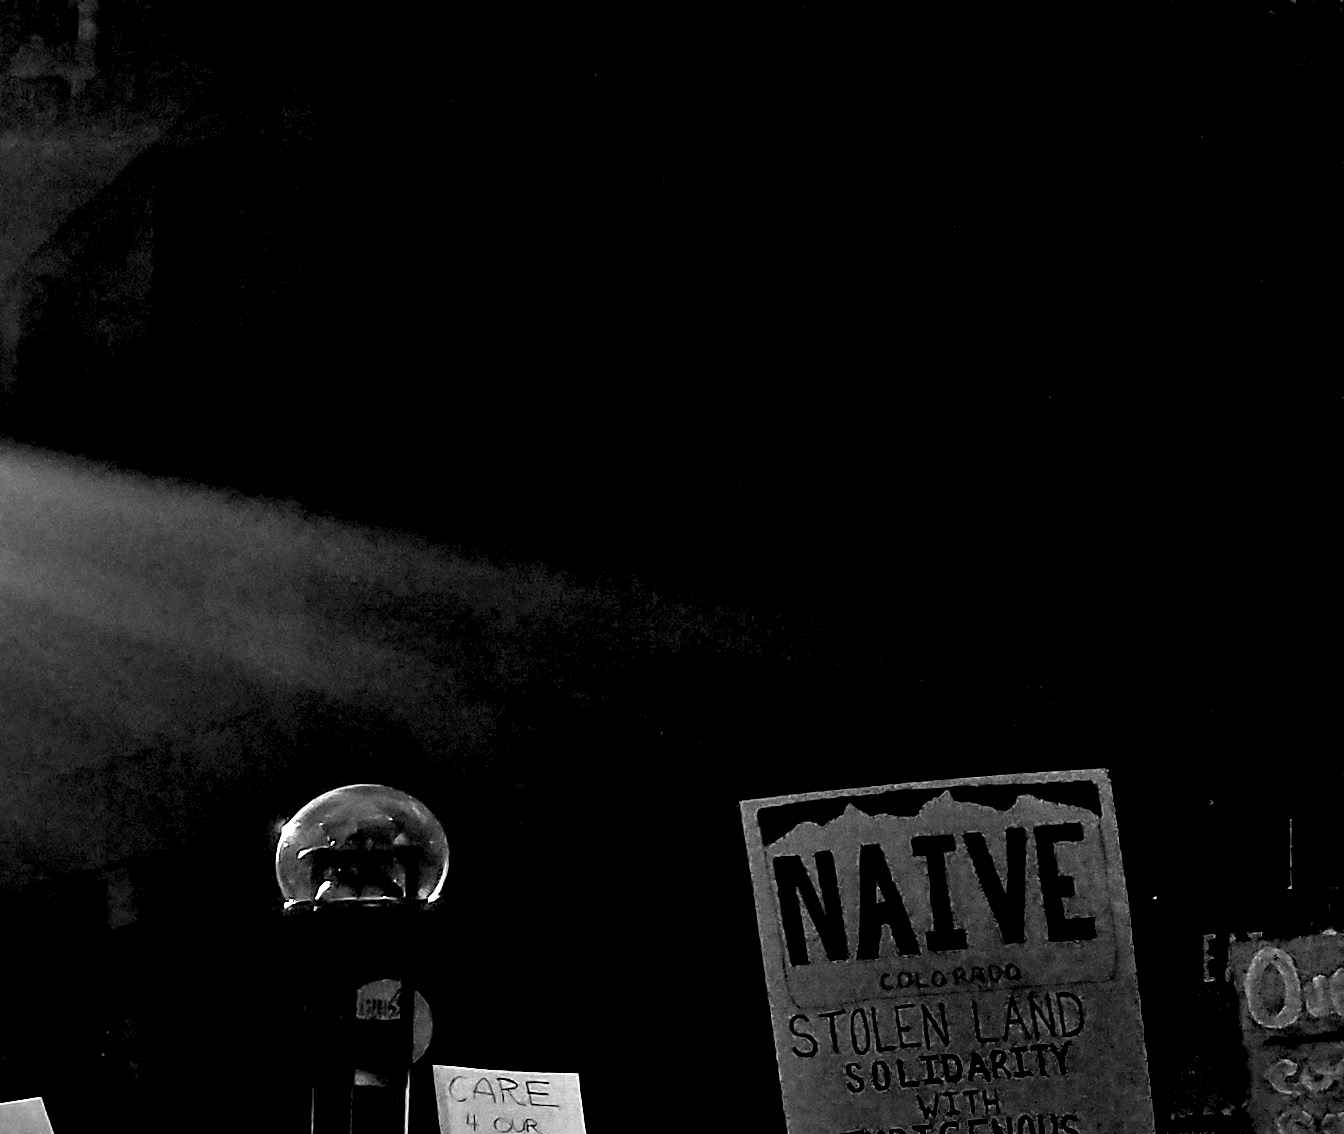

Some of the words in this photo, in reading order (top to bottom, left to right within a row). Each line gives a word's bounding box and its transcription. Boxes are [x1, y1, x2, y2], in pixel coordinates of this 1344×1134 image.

[773, 823, 1098, 967] NAIVE
[879, 962, 1022, 991] COLORADO
[789, 1002, 950, 1058] STOLEN
[972, 991, 1085, 1044] LAND
[845, 1041, 1071, 1094] SOLIDARITY
[449, 1076, 560, 1108] CARE
[916, 1089, 1002, 1118] WITH
[466, 1112, 479, 1132] 4
